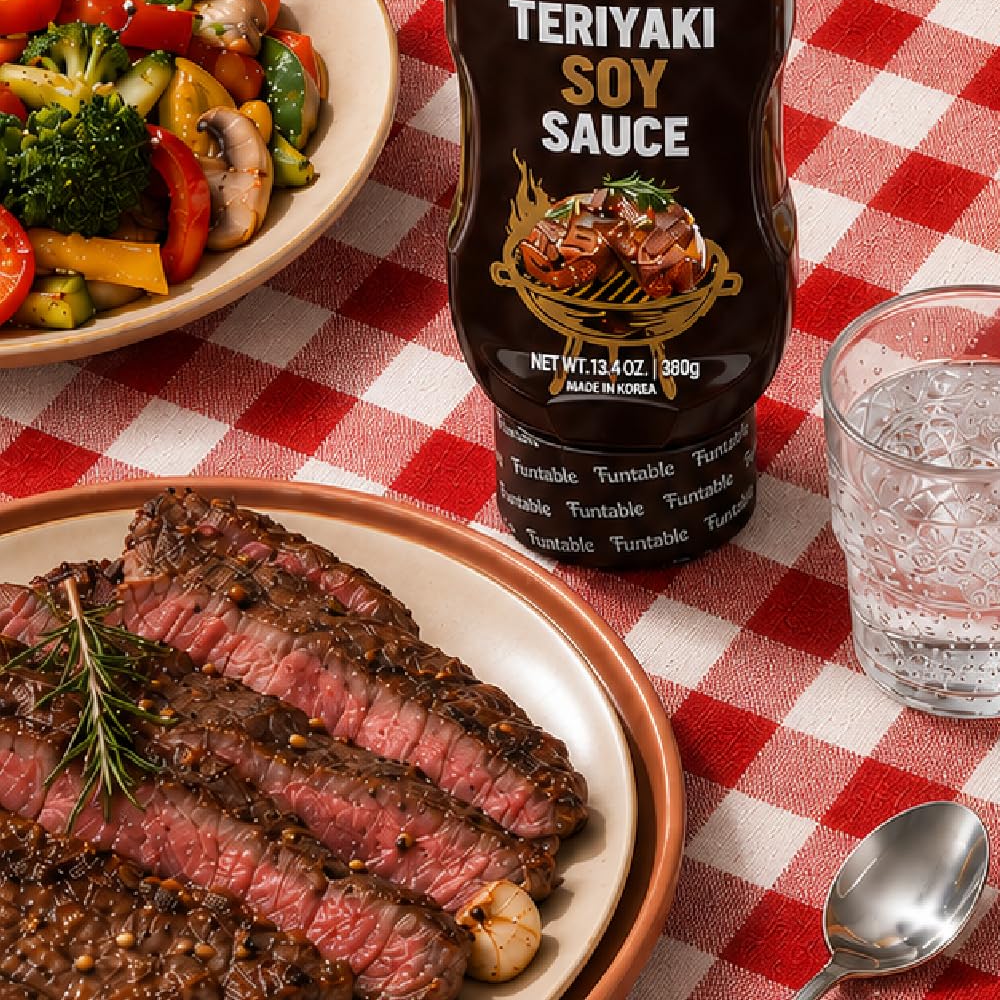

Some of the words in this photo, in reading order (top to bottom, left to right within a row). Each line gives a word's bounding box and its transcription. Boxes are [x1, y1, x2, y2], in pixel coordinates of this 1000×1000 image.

[560, 54, 669, 109] SOY
[541, 110, 690, 157] SAUCE
[531, 352, 560, 372] NET
[623, 360, 648, 377] OZ.
[662, 359, 700, 379] 380g
[566, 381, 600, 393] MADE
[601, 382, 615, 394] IN
[616, 382, 657, 395] KOREA
[510, 456, 579, 484] Funtable
[593, 461, 675, 485] Funtable
[565, 500, 645, 519] Funtable
[662, 473, 734, 510] Funtable
[525, 528, 594, 553] Funtable
[609, 527, 690, 553] Funtable
